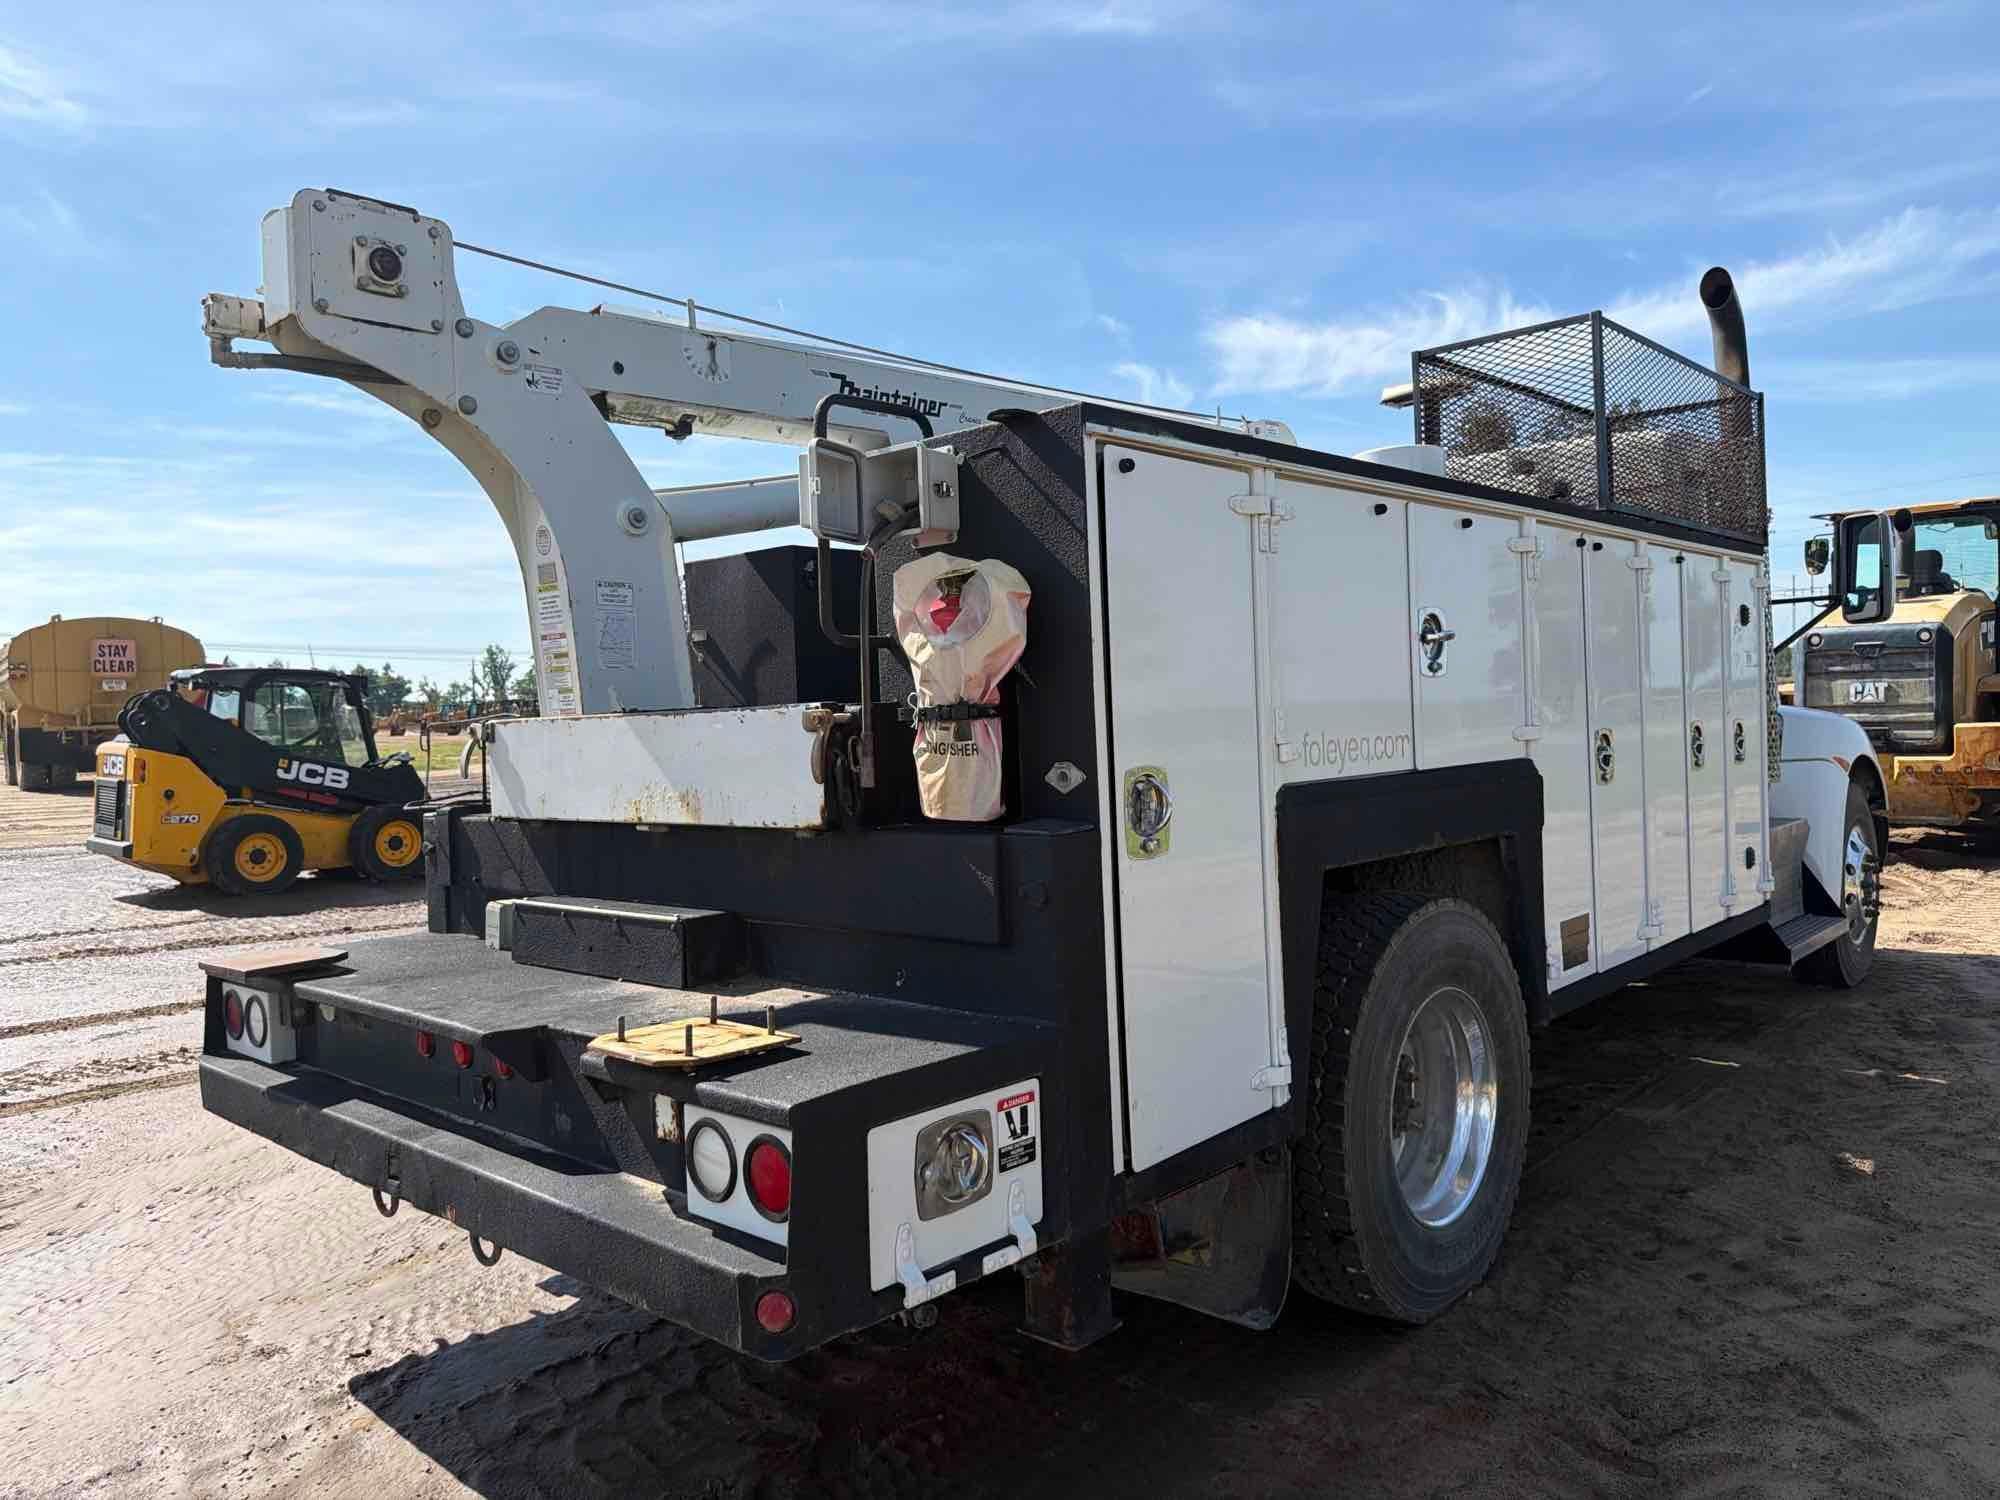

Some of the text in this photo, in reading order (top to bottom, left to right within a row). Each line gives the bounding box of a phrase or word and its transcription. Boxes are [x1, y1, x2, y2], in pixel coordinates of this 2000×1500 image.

[98, 644, 128, 658] STAY
[94, 659, 135, 673] CLEAR
[1849, 681, 1889, 703] CAT
[1302, 730, 1410, 774] foleyeq.com
[104, 755, 124, 776] JCB
[276, 758, 350, 789] JCB
